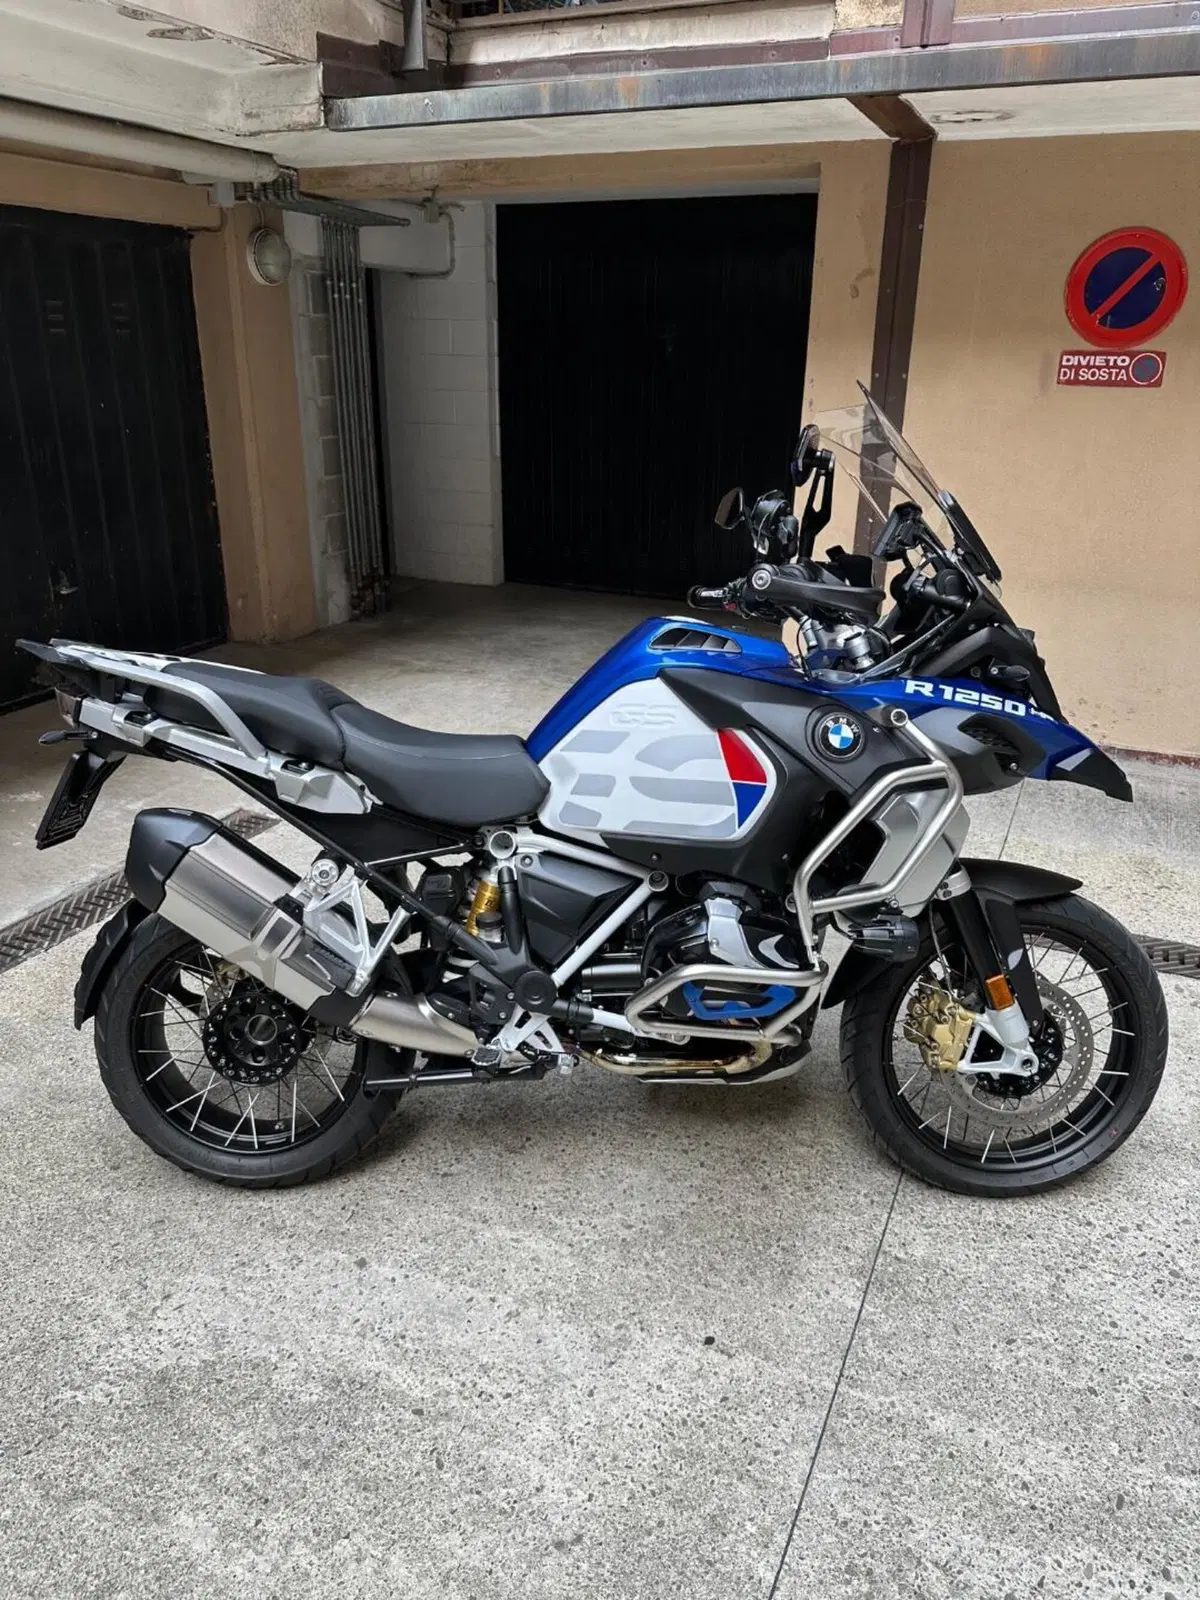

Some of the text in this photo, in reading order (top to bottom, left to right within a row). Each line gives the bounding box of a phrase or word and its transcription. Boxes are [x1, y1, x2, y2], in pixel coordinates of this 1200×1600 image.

[1062, 355, 1131, 366] DIVIETO
[1060, 368, 1127, 381] DI SOSTA
[905, 680, 934, 697] R
[939, 684, 1026, 716] 1250
[826, 717, 859, 736] BMW
